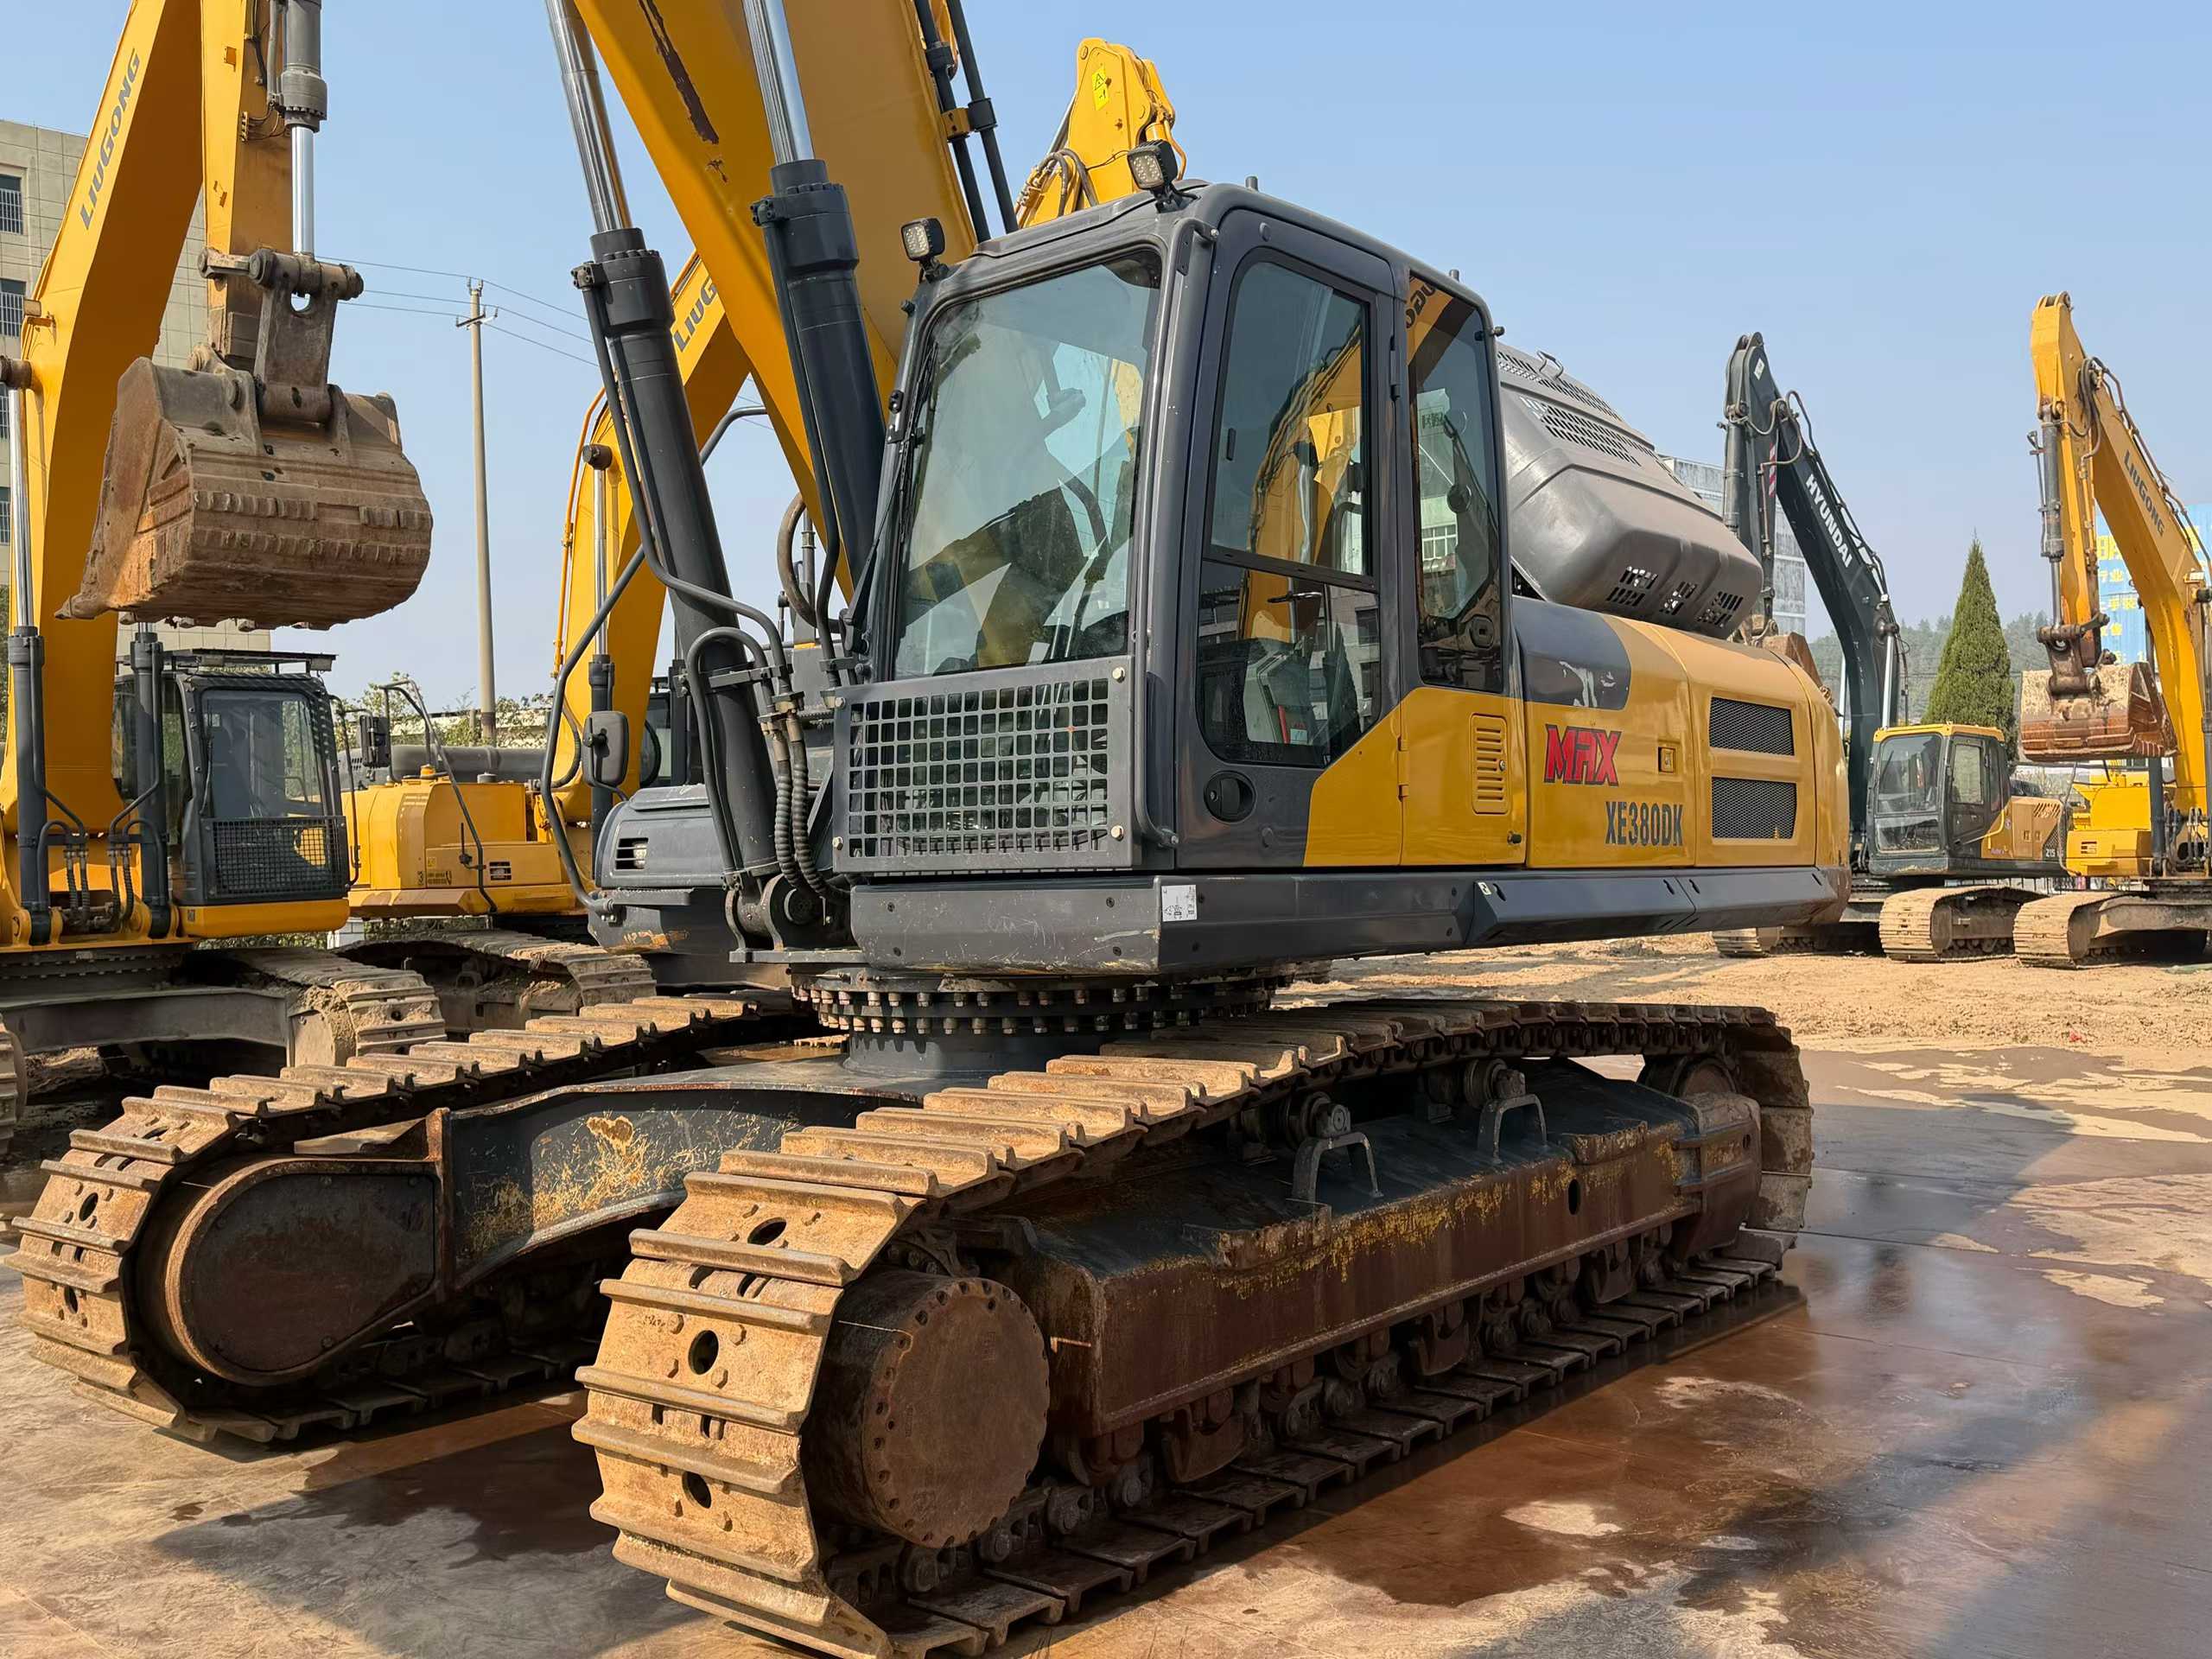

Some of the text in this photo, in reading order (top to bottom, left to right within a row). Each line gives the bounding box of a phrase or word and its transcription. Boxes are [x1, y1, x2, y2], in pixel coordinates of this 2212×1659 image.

[79, 48, 140, 230] LIUGONG
[674, 276, 717, 353] LIUG
[1806, 474, 1853, 568] HYUNDAI
[2125, 449, 2164, 537] LIUGONG
[1543, 723, 1623, 787] MAX
[1605, 801, 1683, 847] XE380DK
